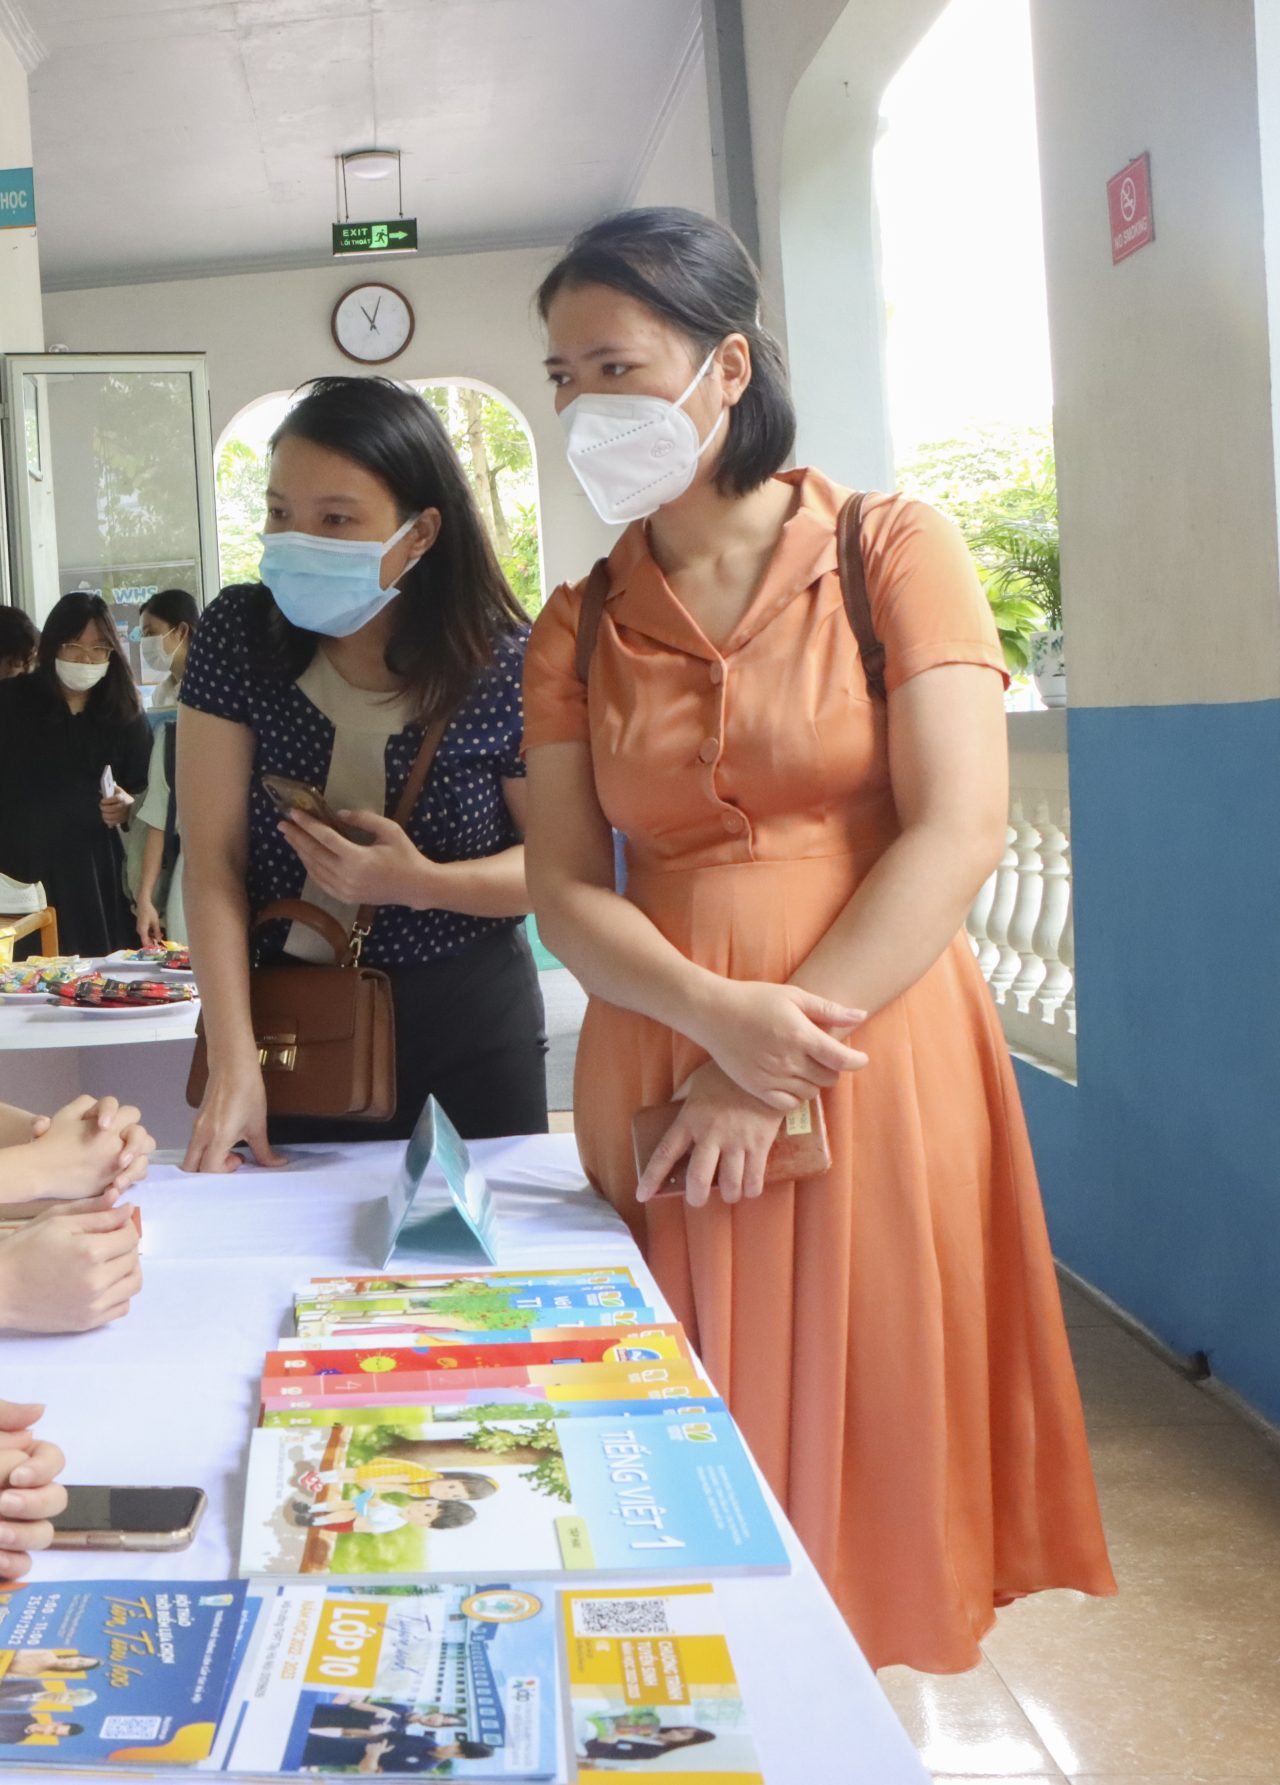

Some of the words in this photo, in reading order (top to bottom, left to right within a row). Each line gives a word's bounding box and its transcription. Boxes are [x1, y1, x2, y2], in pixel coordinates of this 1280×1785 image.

[0, 190, 27, 215] HỌC
[341, 238, 351, 246] LỐI
[352, 238, 371, 246] THOÁT
[342, 227, 369, 237] EXIT
[600, 1429, 652, 1483] TIẾNG
[609, 1486, 667, 1530] VIỆT
[629, 1535, 687, 1550] 1
[42, 1594, 61, 1614] 9:00
[8, 1595, 43, 1645] 25/09/2022
[176, 1608, 195, 1627] THẢO
[326, 1607, 378, 1651] LỚP
[27, 1622, 49, 1646] 11:00
[157, 1642, 176, 1664] CHỌN
[658, 1641, 678, 1674] CHƯƠNG
[105, 1664, 144, 1688] học
[319, 1655, 361, 1677] 10
[665, 1674, 686, 1701] TRÌNH
